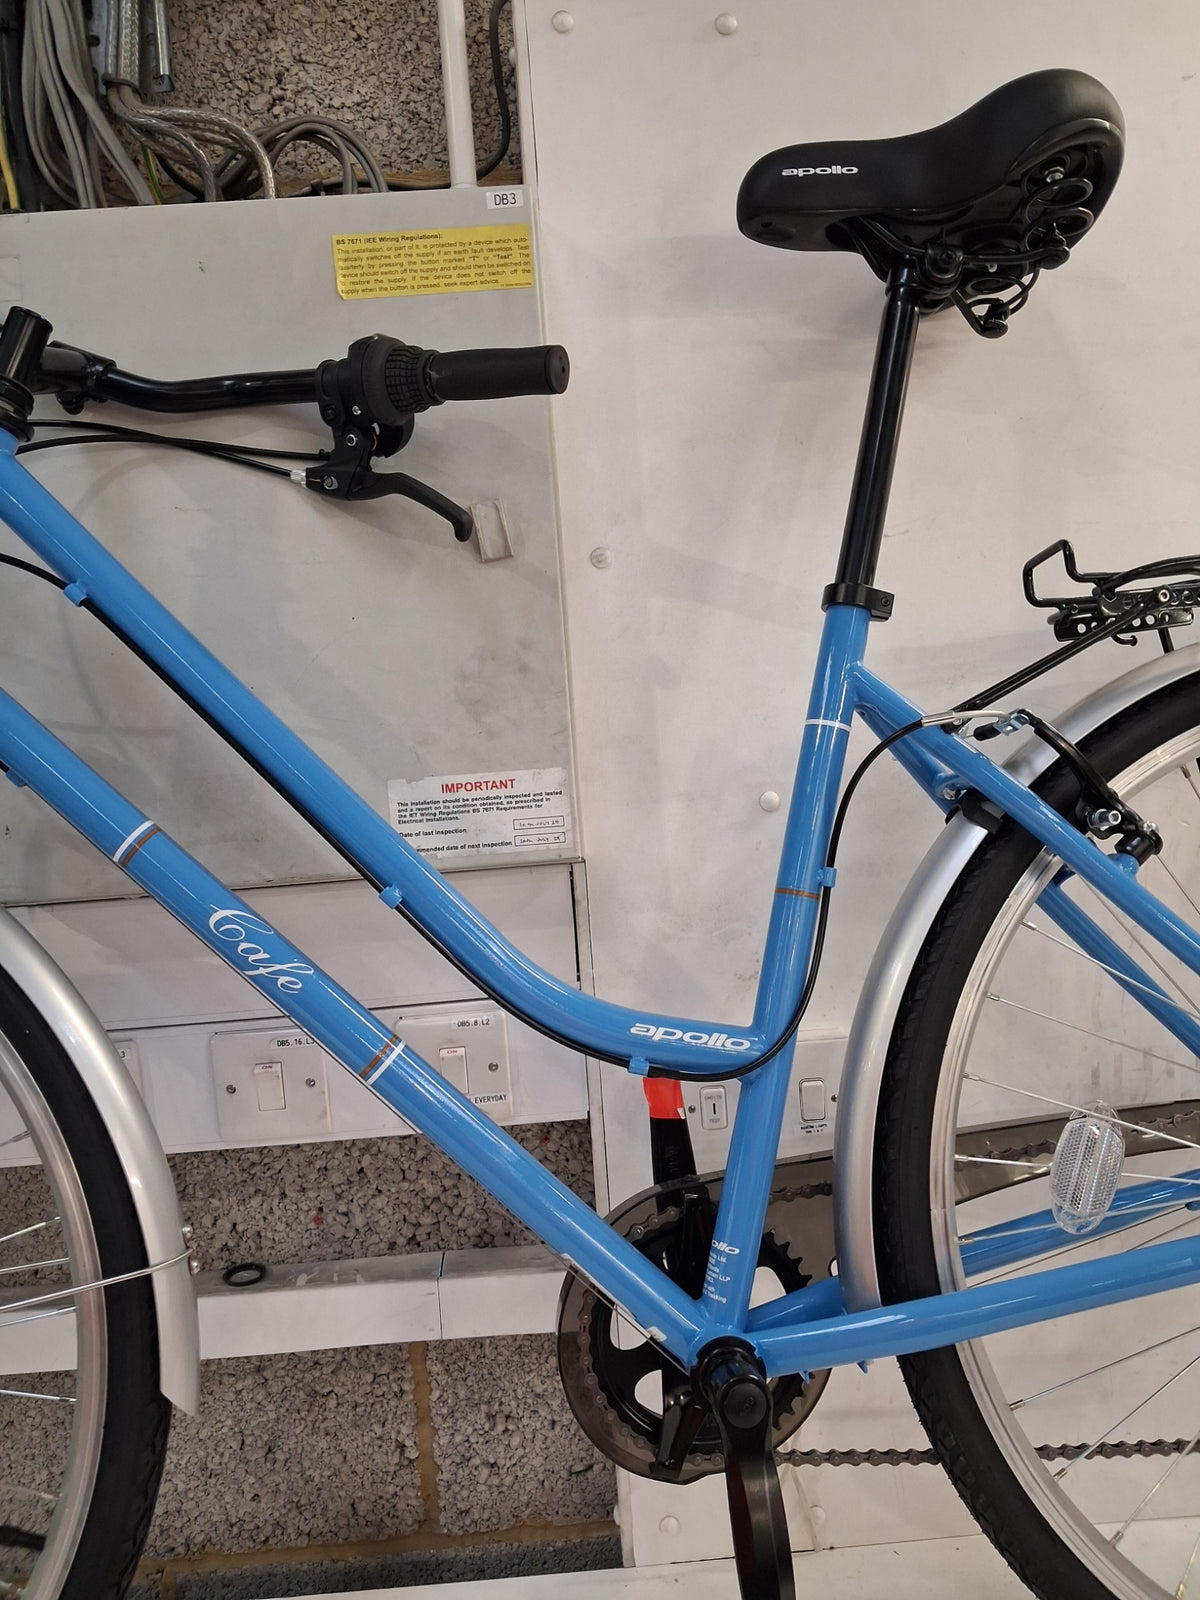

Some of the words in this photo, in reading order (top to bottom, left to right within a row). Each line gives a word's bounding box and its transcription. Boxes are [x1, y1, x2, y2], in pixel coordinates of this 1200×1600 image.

[781, 165, 858, 177] apollo
[494, 192, 517, 206] DB3
[441, 779, 516, 794] IMPORTANT
[471, 795, 502, 803] periodically
[515, 797, 544, 805] prescribed
[208, 904, 314, 994] Cafe
[457, 1019, 490, 1027] DB5.8.L2
[630, 1023, 751, 1050] apollo
[474, 1094, 507, 1104] EVERYDAY
[712, 1240, 740, 1254] ollo
